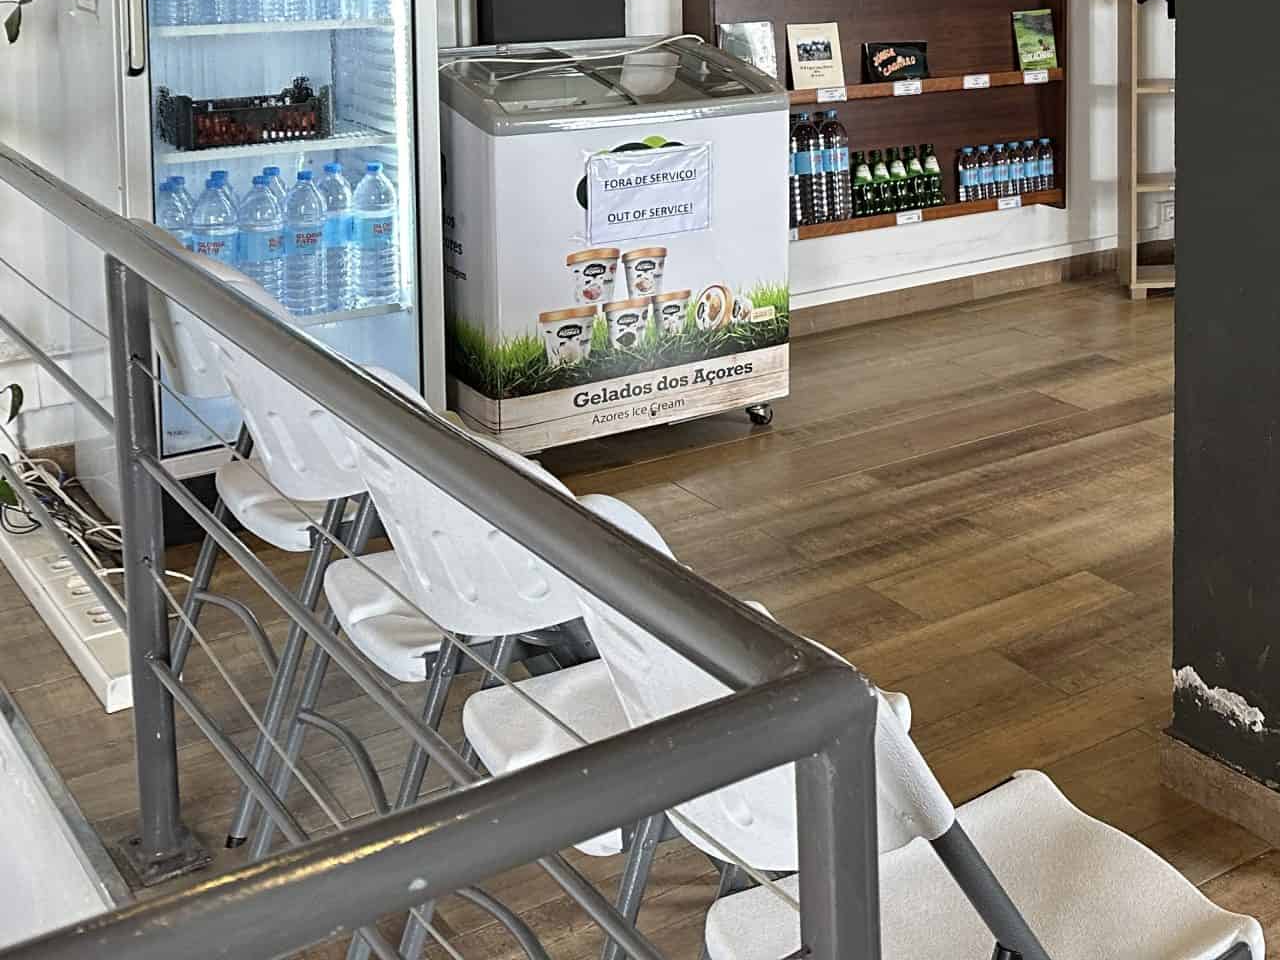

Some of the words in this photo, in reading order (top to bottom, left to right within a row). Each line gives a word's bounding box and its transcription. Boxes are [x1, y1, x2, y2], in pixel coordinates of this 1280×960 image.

[604, 178, 633, 190] FORA
[635, 175, 648, 186] DE
[649, 168, 697, 184] SERVIÇO!
[607, 210, 631, 223] OUT
[632, 209, 648, 220] OF
[649, 202, 694, 218] SERVICE!
[573, 383, 652, 408] Gelados
[656, 375, 689, 392] dos
[692, 361, 753, 386] Açores
[591, 407, 630, 425] Azores
[632, 406, 648, 418] Ice
[650, 397, 686, 417] Cream
